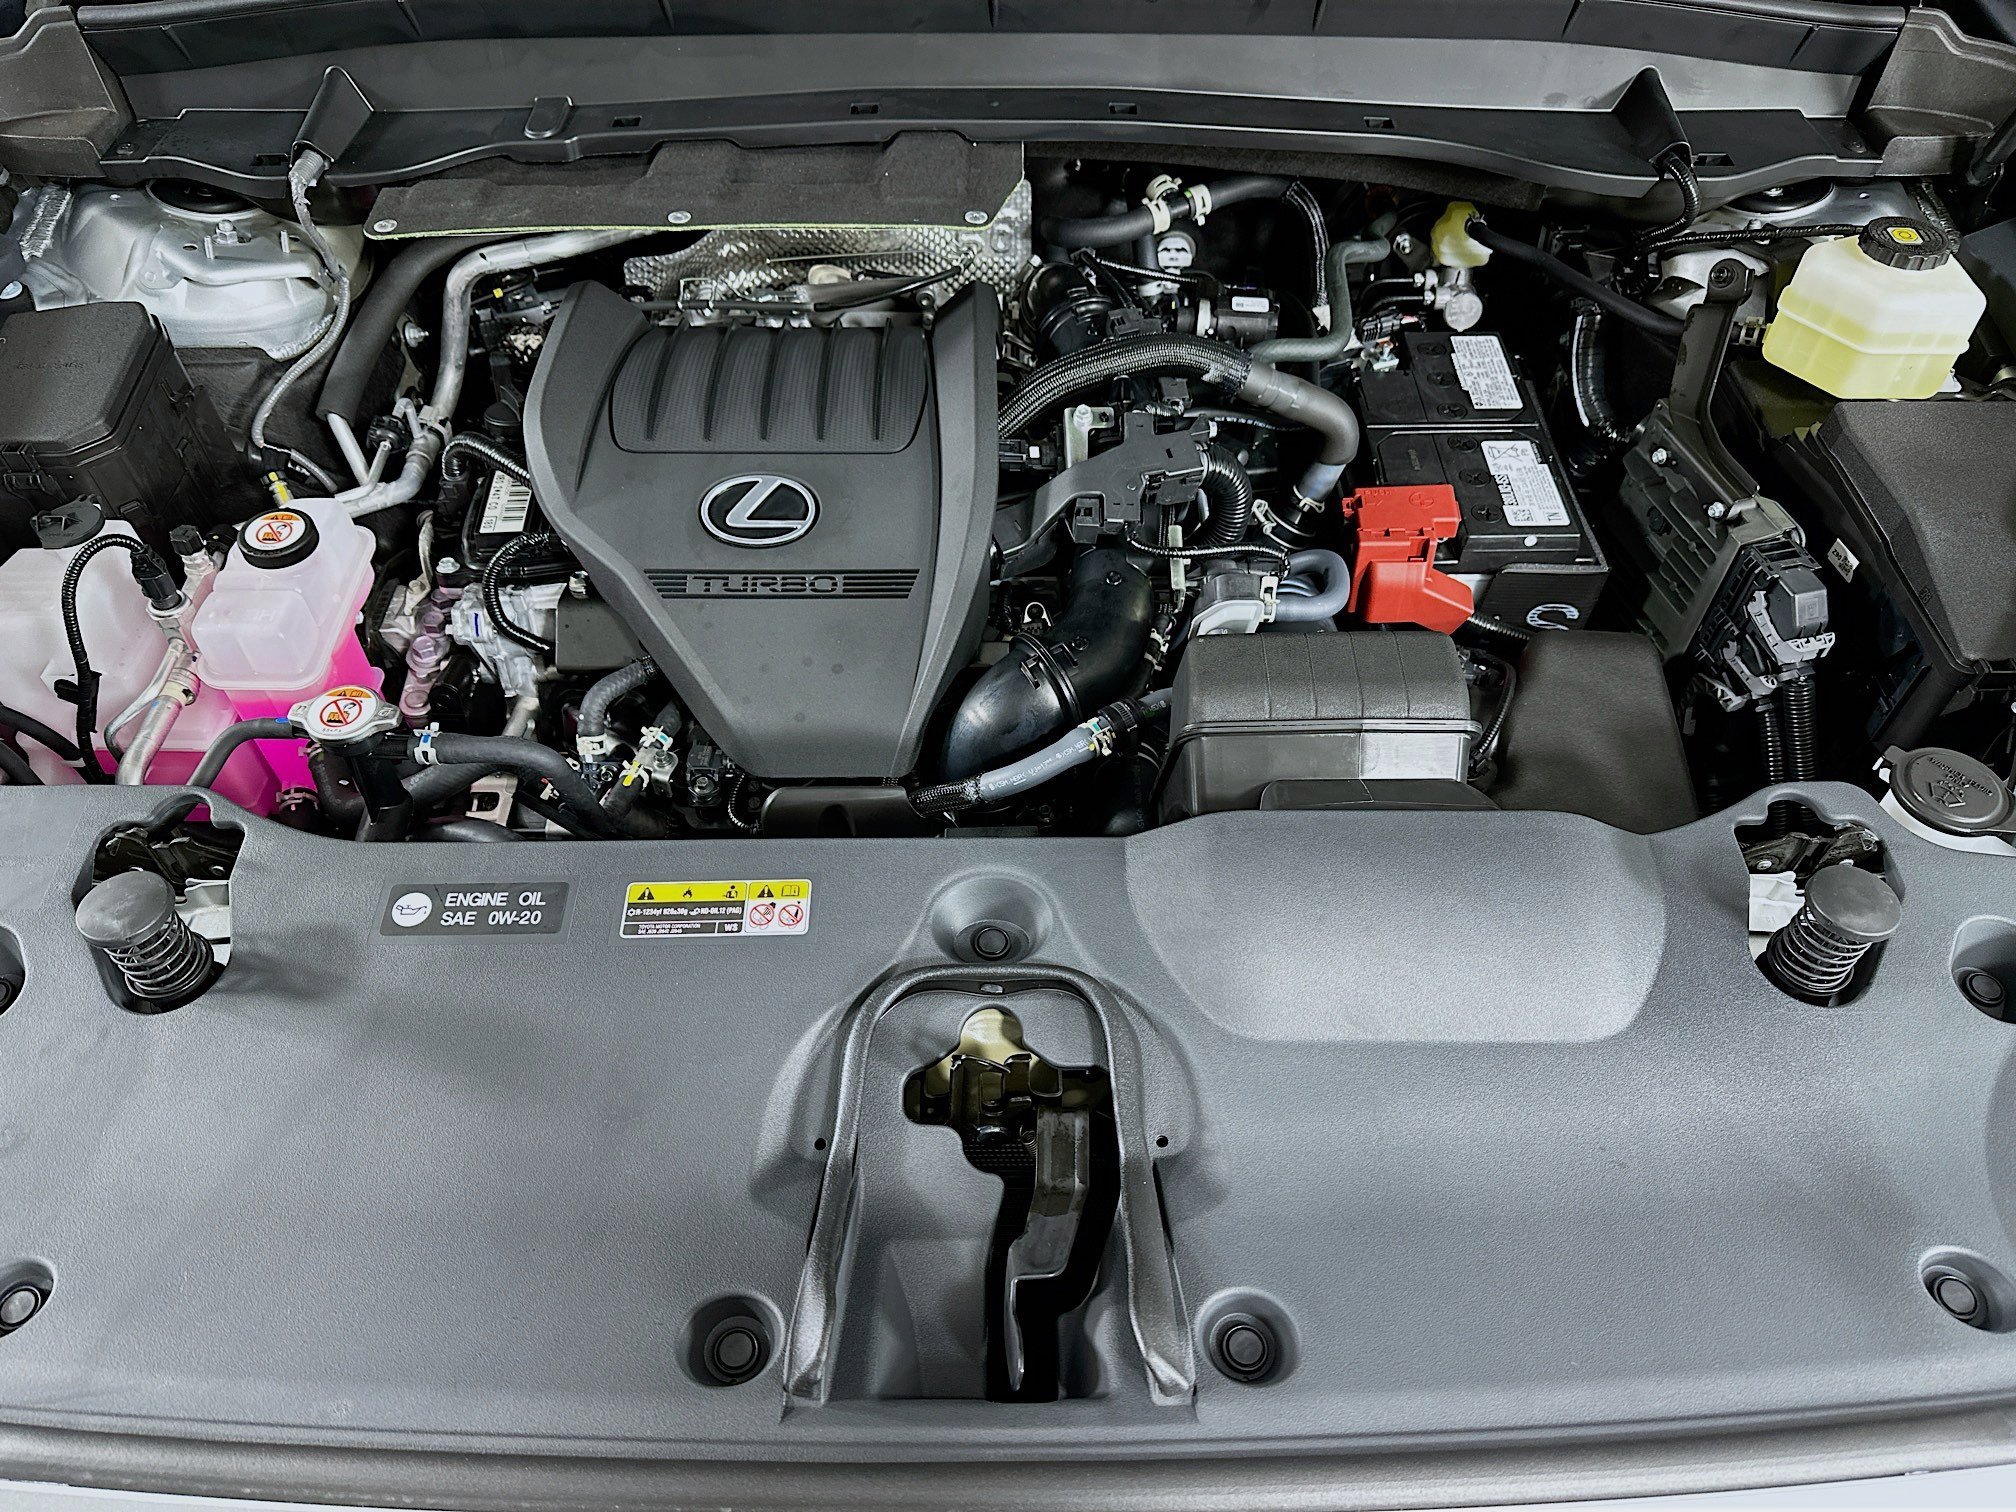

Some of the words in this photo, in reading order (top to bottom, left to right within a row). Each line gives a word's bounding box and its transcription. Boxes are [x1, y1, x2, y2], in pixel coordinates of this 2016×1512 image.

[691, 575, 839, 594] TURBO
[444, 892, 509, 907] ENGINE
[518, 891, 546, 906] OIL
[440, 911, 477, 926] SAE
[488, 910, 542, 925] 0W-20
[724, 923, 738, 932] WS
